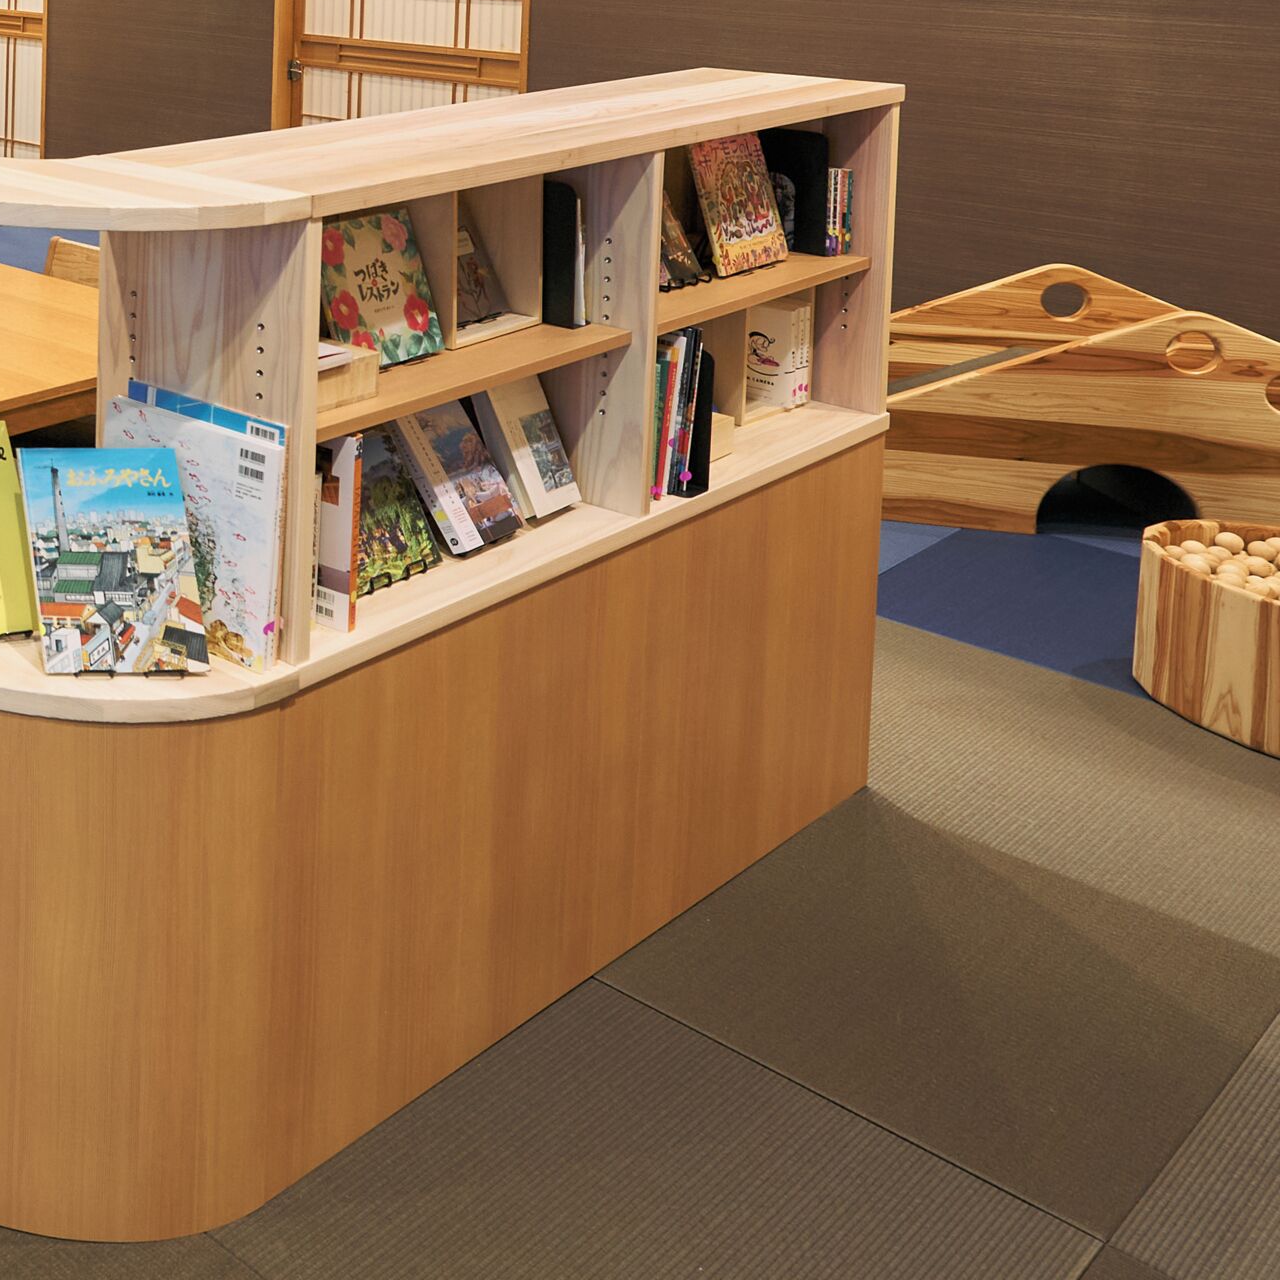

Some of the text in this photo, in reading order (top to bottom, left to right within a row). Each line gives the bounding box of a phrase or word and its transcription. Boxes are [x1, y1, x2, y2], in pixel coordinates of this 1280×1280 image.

[358, 281, 400, 302] レストラン
